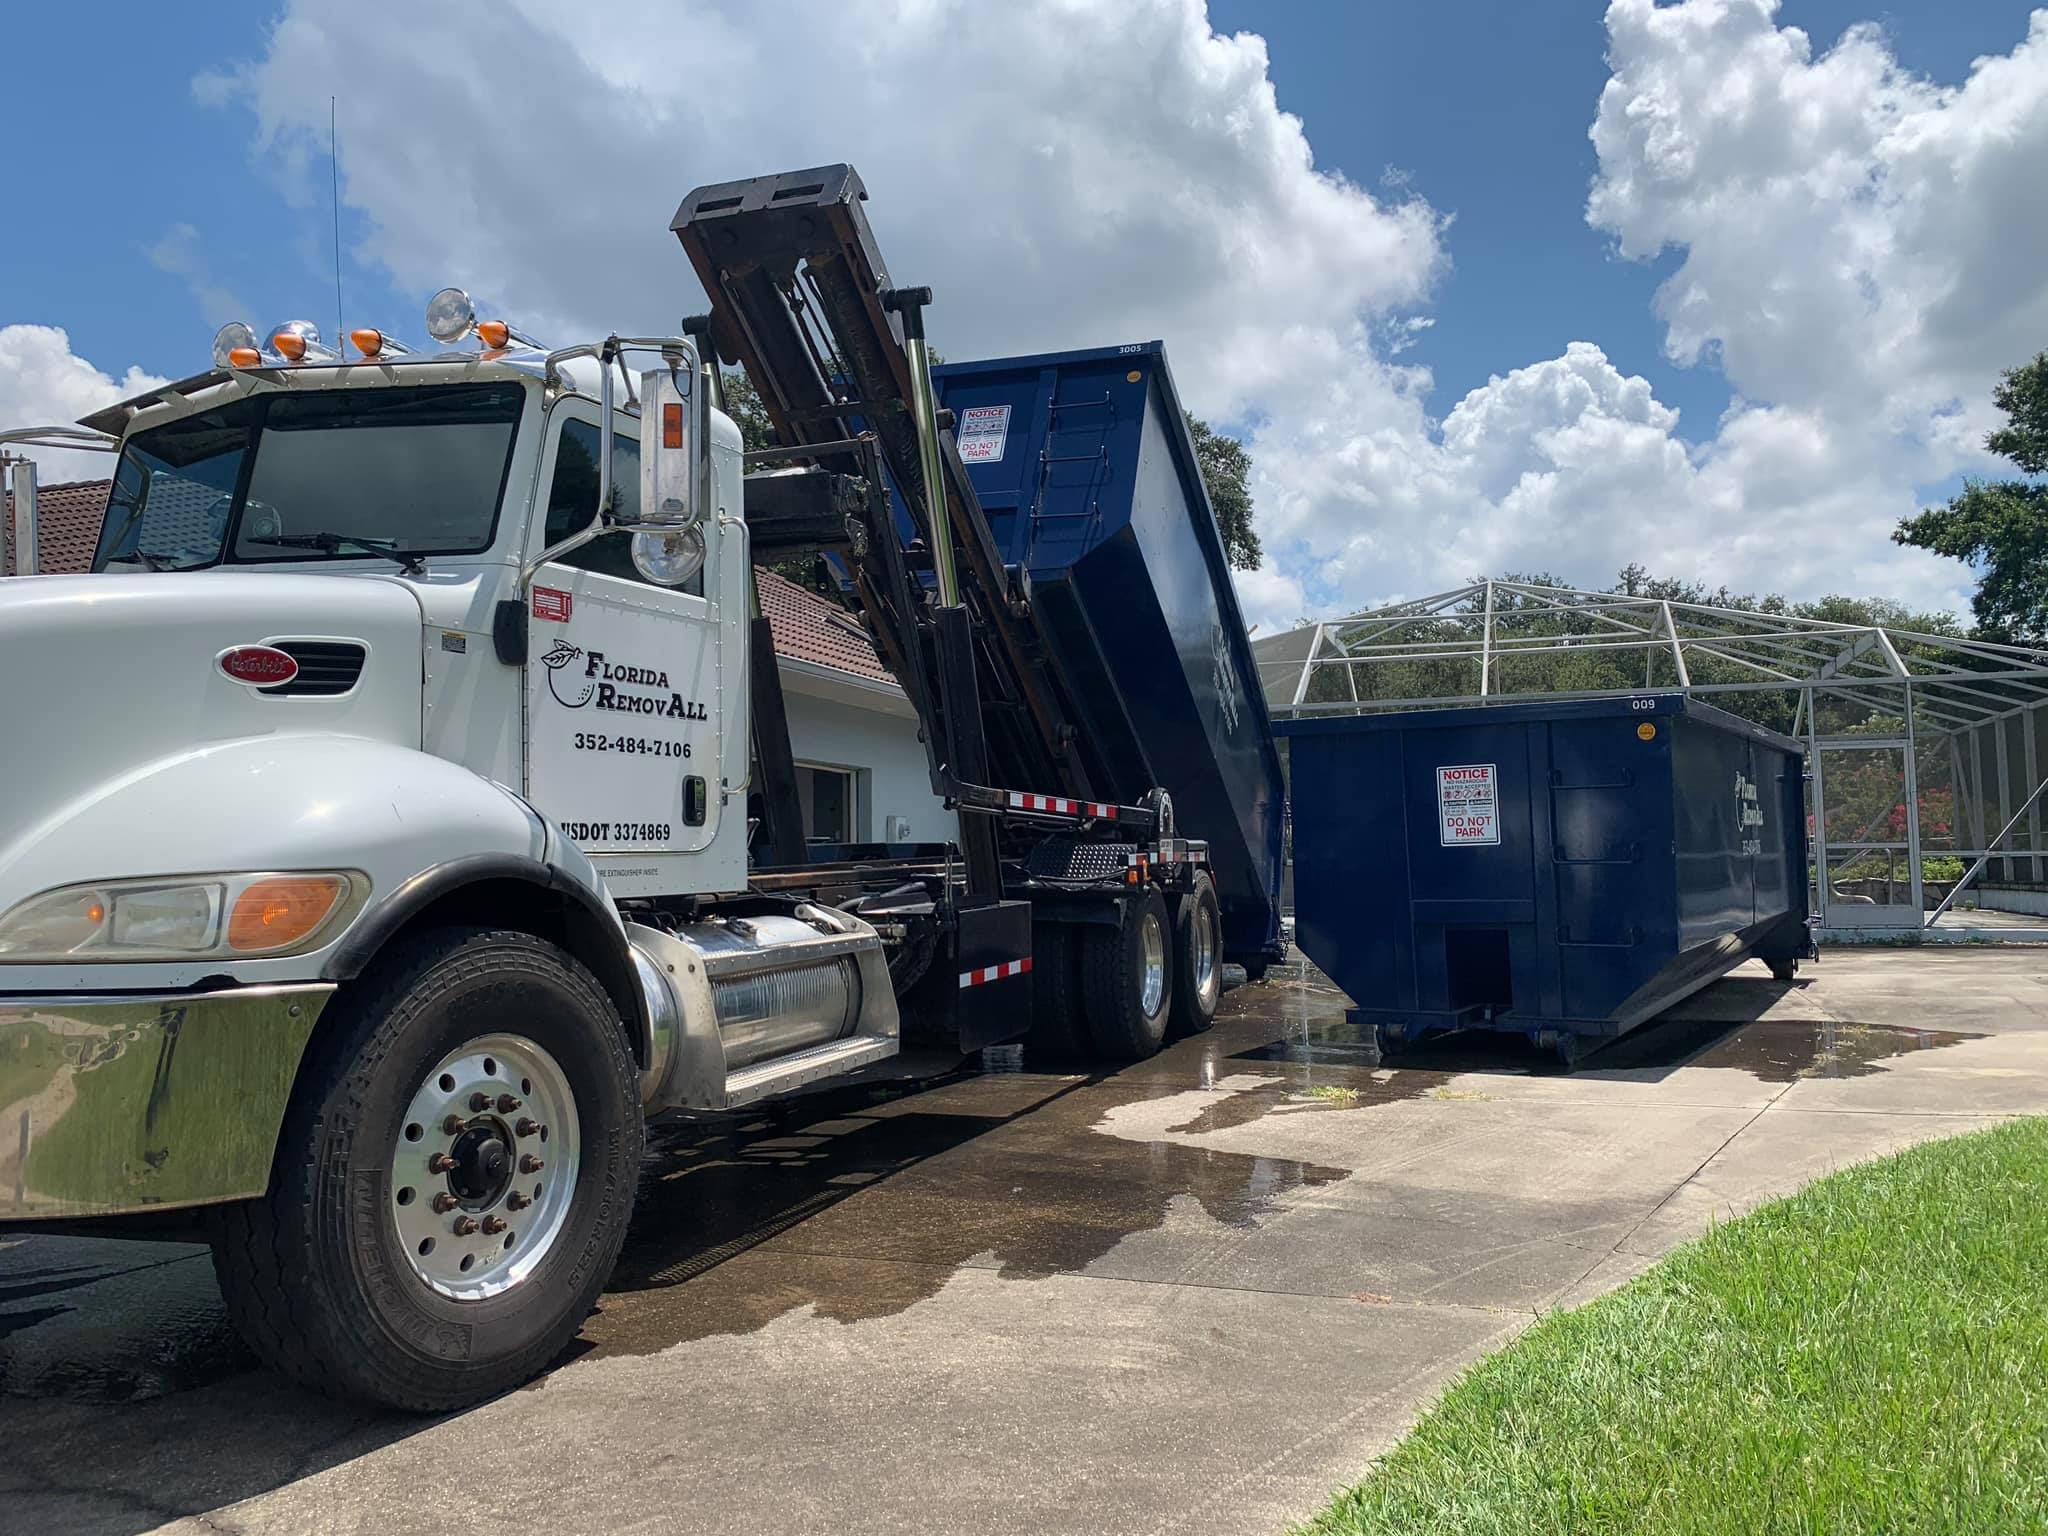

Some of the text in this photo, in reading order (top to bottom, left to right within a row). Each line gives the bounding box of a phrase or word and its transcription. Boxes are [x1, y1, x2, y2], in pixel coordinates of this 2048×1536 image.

[1119, 345, 1142, 354] 3005
[968, 409, 1004, 418] NOTICE
[962, 441, 999, 451] DO NOT
[967, 449, 991, 457] PARK
[231, 655, 291, 673] Peterbilt
[585, 651, 669, 688] FLORIDA
[1632, 699, 1655, 709] 009
[574, 732, 692, 758] 352-484-7106
[1443, 769, 1488, 780] NOTICE
[1447, 816, 1491, 827] DO NOT
[614, 823, 670, 841] 3374869
[1456, 827, 1484, 837] PARK
